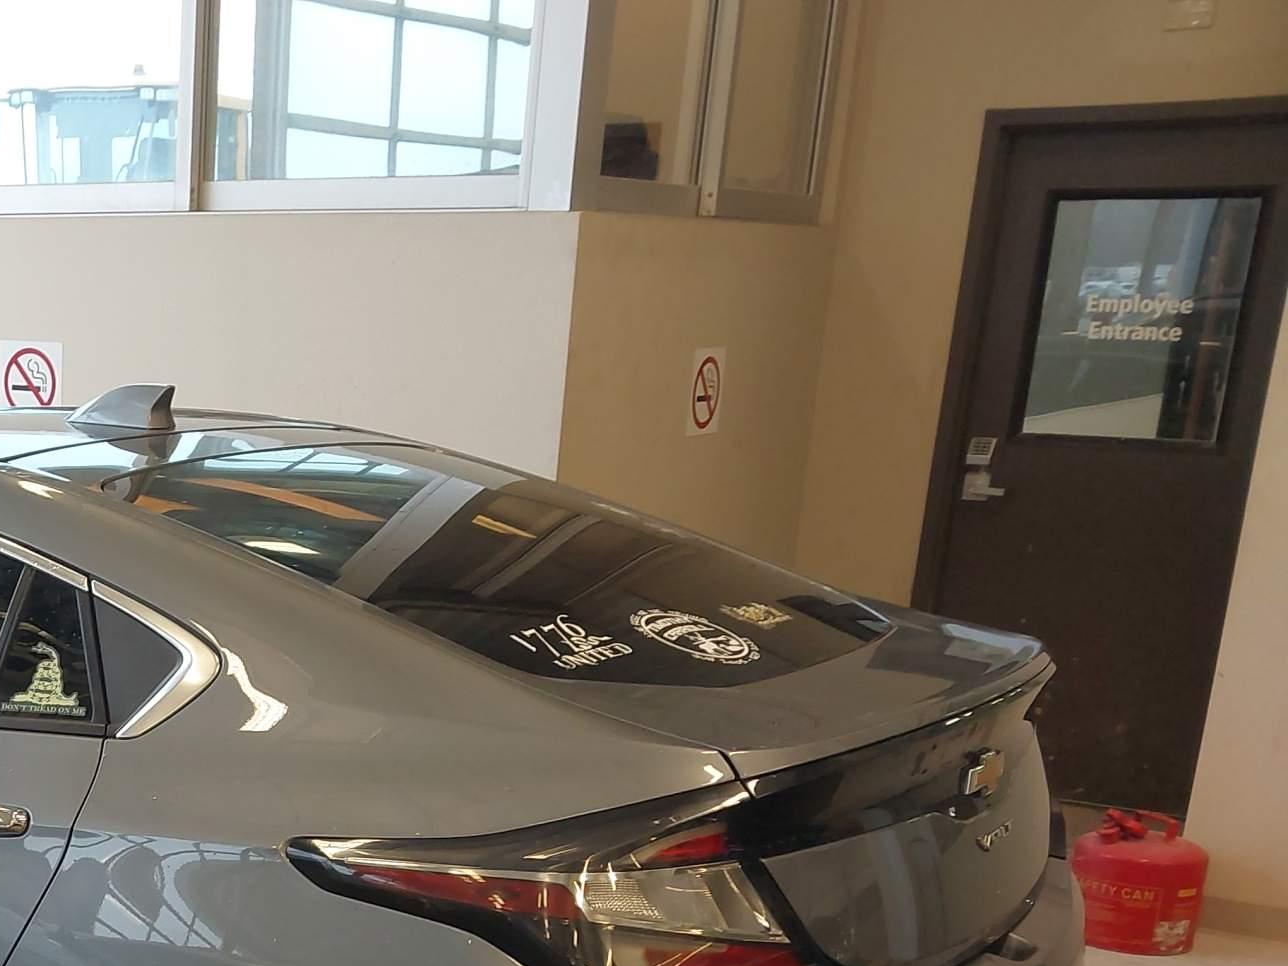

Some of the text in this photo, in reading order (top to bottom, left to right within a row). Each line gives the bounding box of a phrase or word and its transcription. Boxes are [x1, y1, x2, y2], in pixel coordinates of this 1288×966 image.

[1085, 293, 1194, 320] Employee
[1087, 321, 1183, 342] Entrance
[509, 613, 586, 657] 1776
[552, 642, 633, 670] UNITED
[29, 703, 57, 714] TREAD
[58, 705, 70, 714] ON
[71, 706, 87, 716] ME
[1121, 887, 1155, 901] CAN
